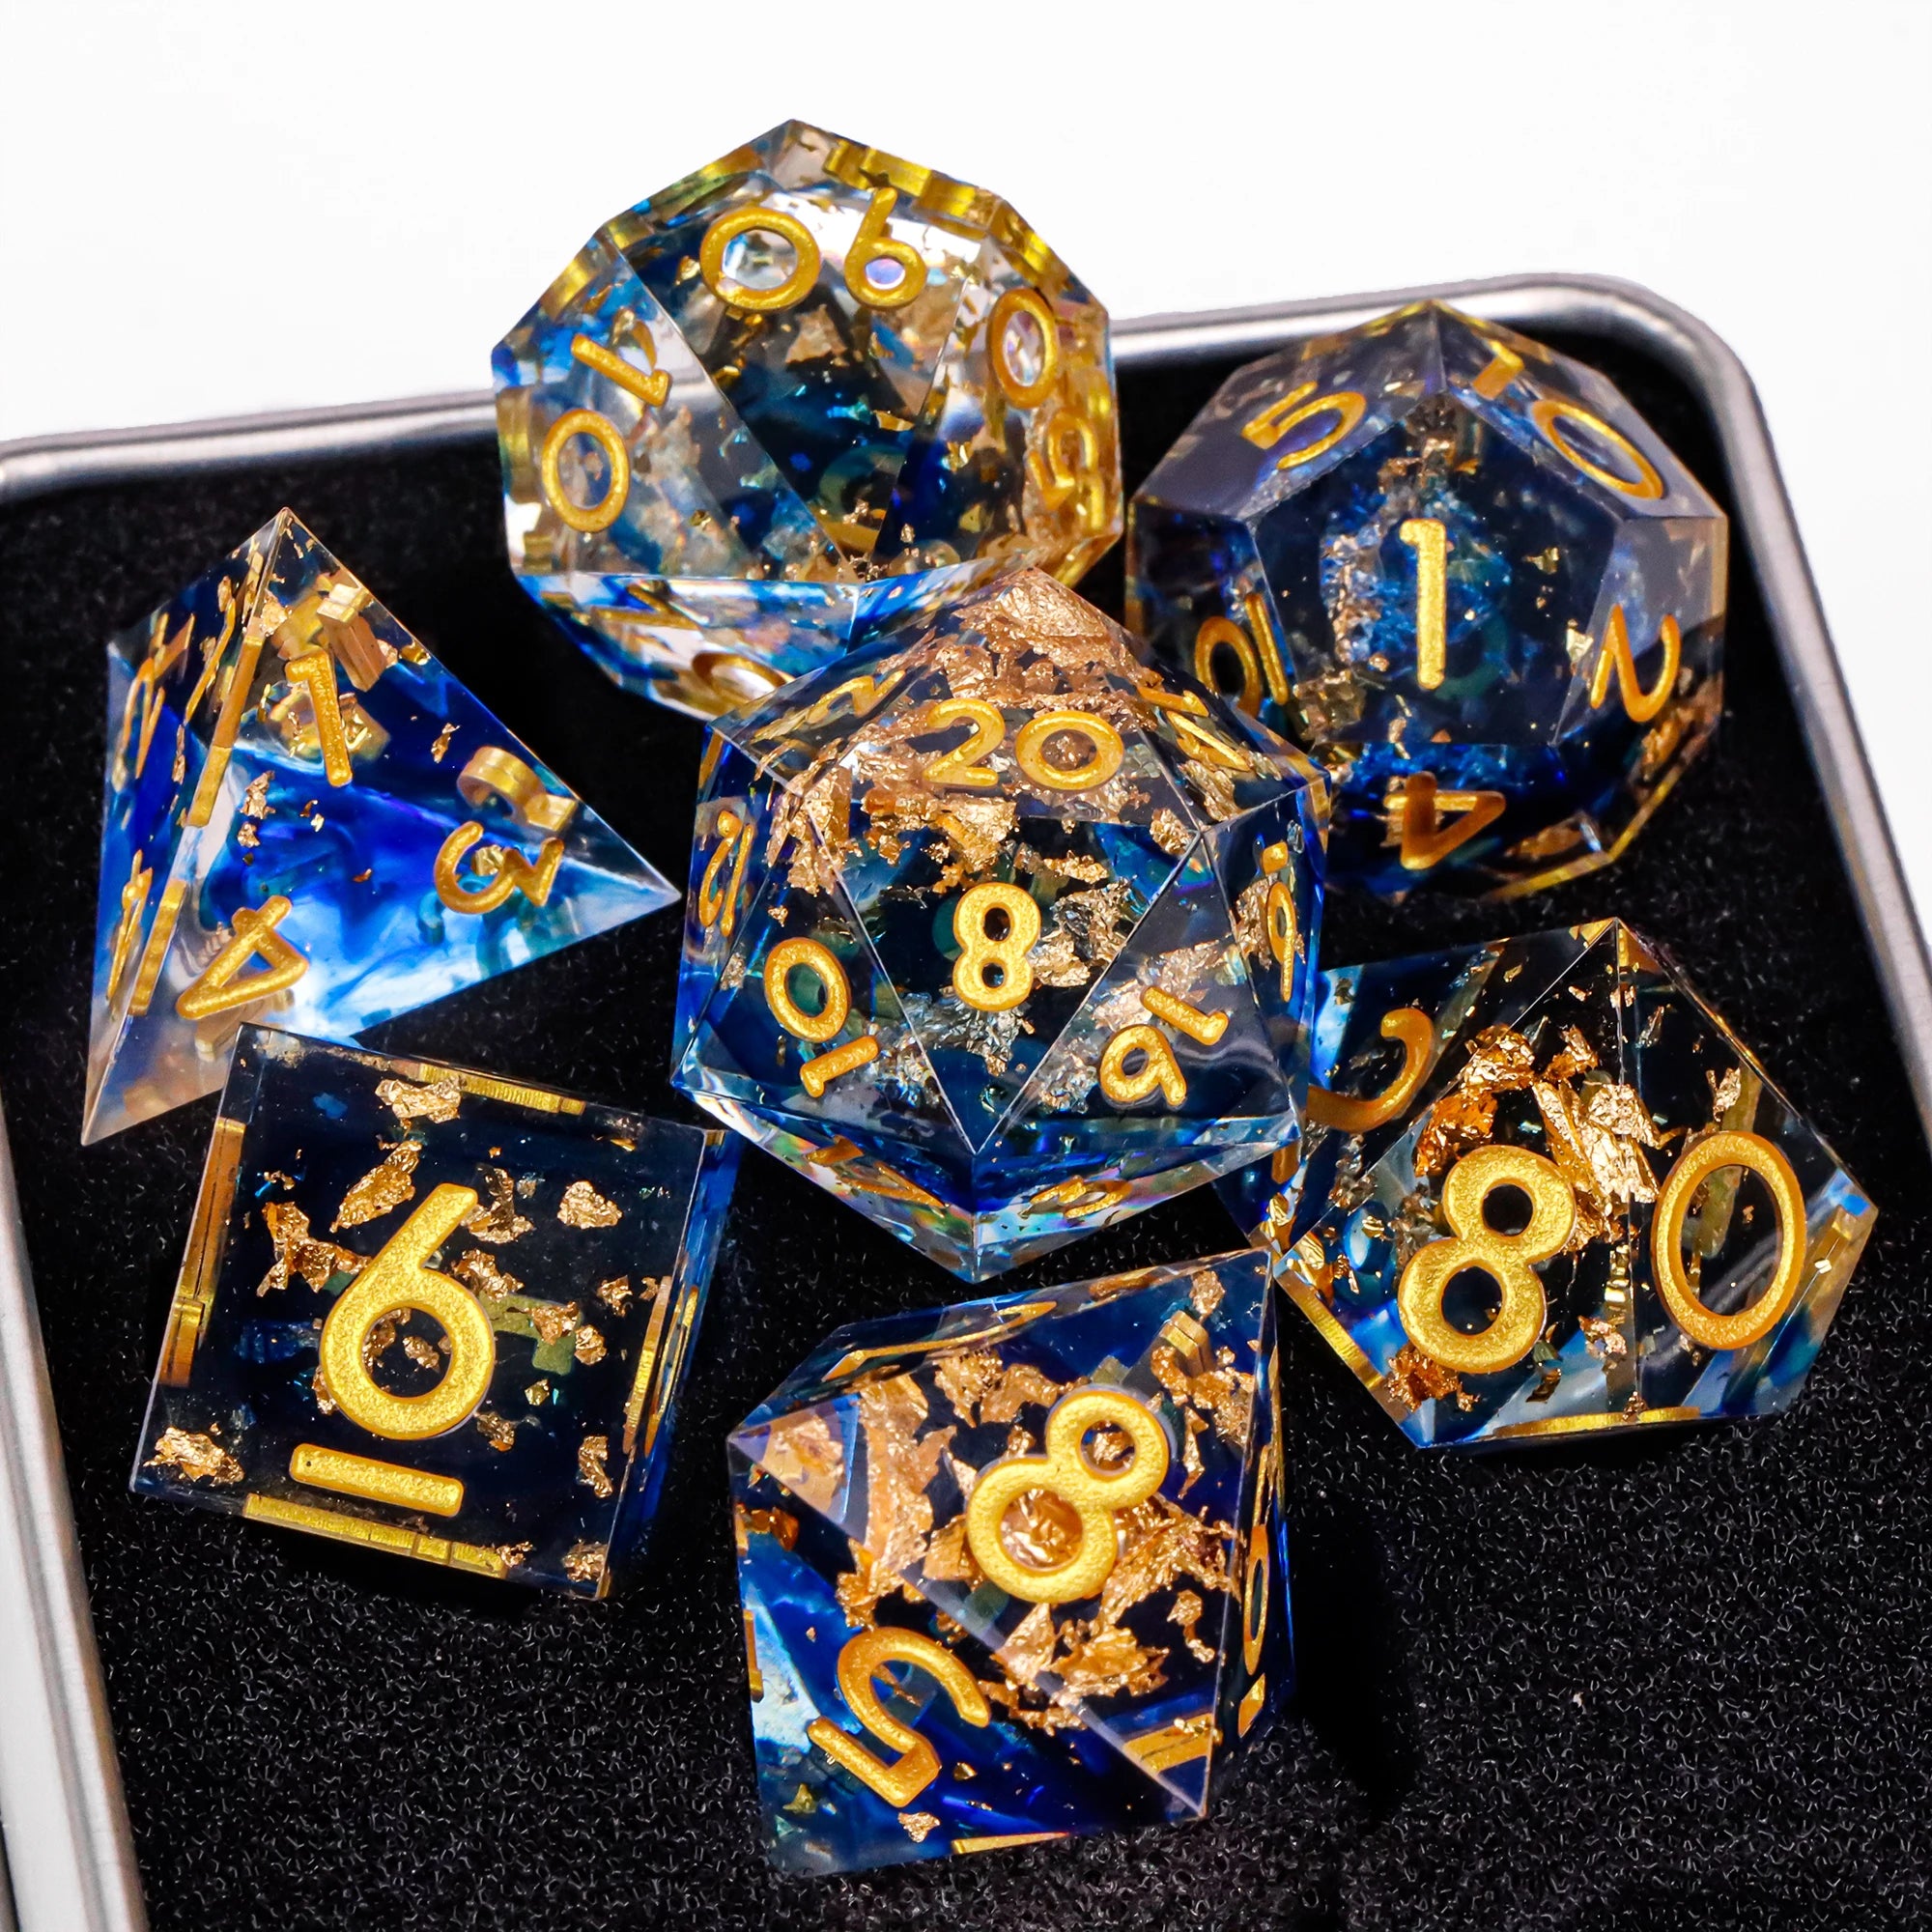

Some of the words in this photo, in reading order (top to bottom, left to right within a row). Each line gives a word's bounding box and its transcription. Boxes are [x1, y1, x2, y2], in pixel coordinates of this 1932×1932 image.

[542, 333, 671, 532] 10
[1241, 381, 1367, 470] 5
[1472, 340, 1664, 500] 10
[1400, 518, 1446, 690] 1
[1589, 604, 1681, 722] 2
[284, 649, 352, 787] 1
[923, 696, 1124, 791] 20
[1383, 770, 1506, 869] 4
[175, 895, 308, 1019] 4
[764, 937, 880, 1099] 10
[952, 882, 1041, 1012] 8
[315, 1181, 495, 1440] 6
[1397, 1144, 1577, 1375] 8
[1651, 1130, 1806, 1350] 0
[966, 1389, 1170, 1605] 8
[807, 1625, 991, 1808] 5
